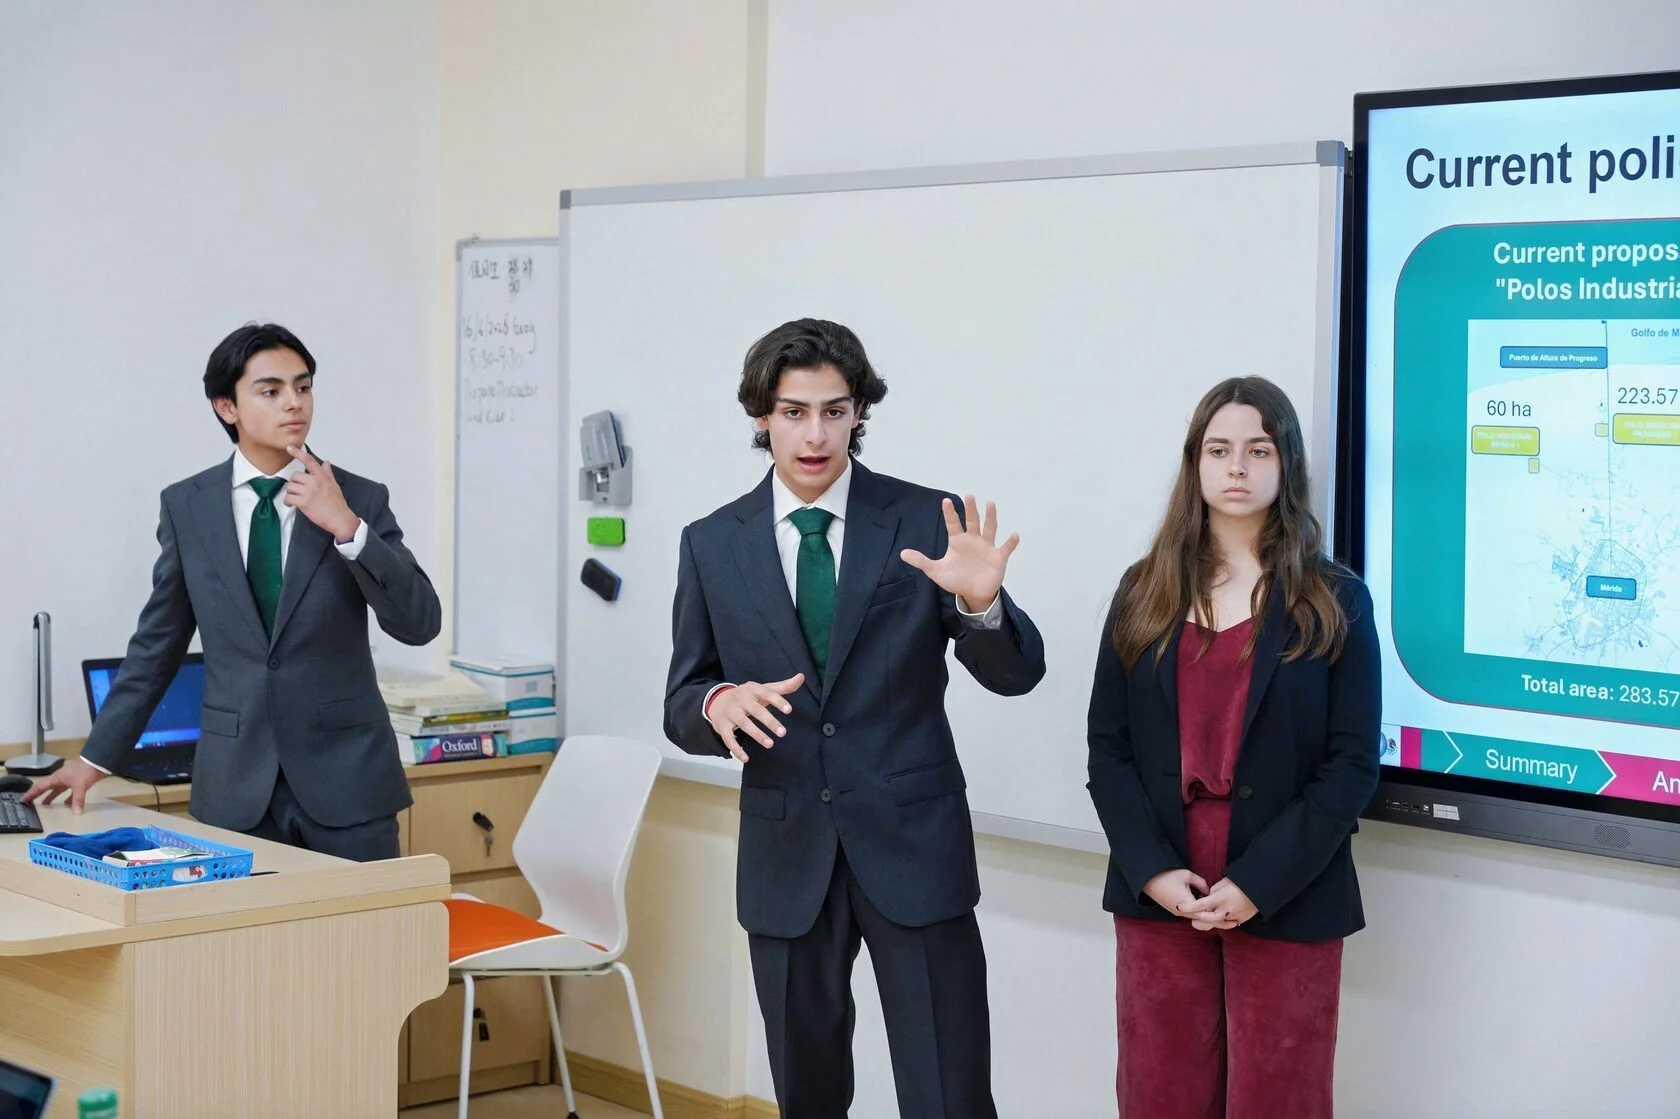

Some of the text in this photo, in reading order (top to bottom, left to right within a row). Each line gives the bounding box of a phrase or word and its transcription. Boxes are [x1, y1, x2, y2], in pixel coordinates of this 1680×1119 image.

[1406, 134, 1680, 193] Current poli
[1493, 242, 1680, 267] Current propos
[1496, 277, 1572, 300] "Polos
[1631, 328, 1655, 337] Golfo
[1658, 328, 1669, 337] de
[1569, 355, 1598, 363] Progreso
[1617, 387, 1679, 405] 223.57
[1487, 400, 1531, 417] 60 ha
[1521, 674, 1680, 707] Total area: 283.57
[442, 738, 478, 752] Oxford
[1485, 748, 1578, 784] Summary
[1652, 770, 1680, 795] An
